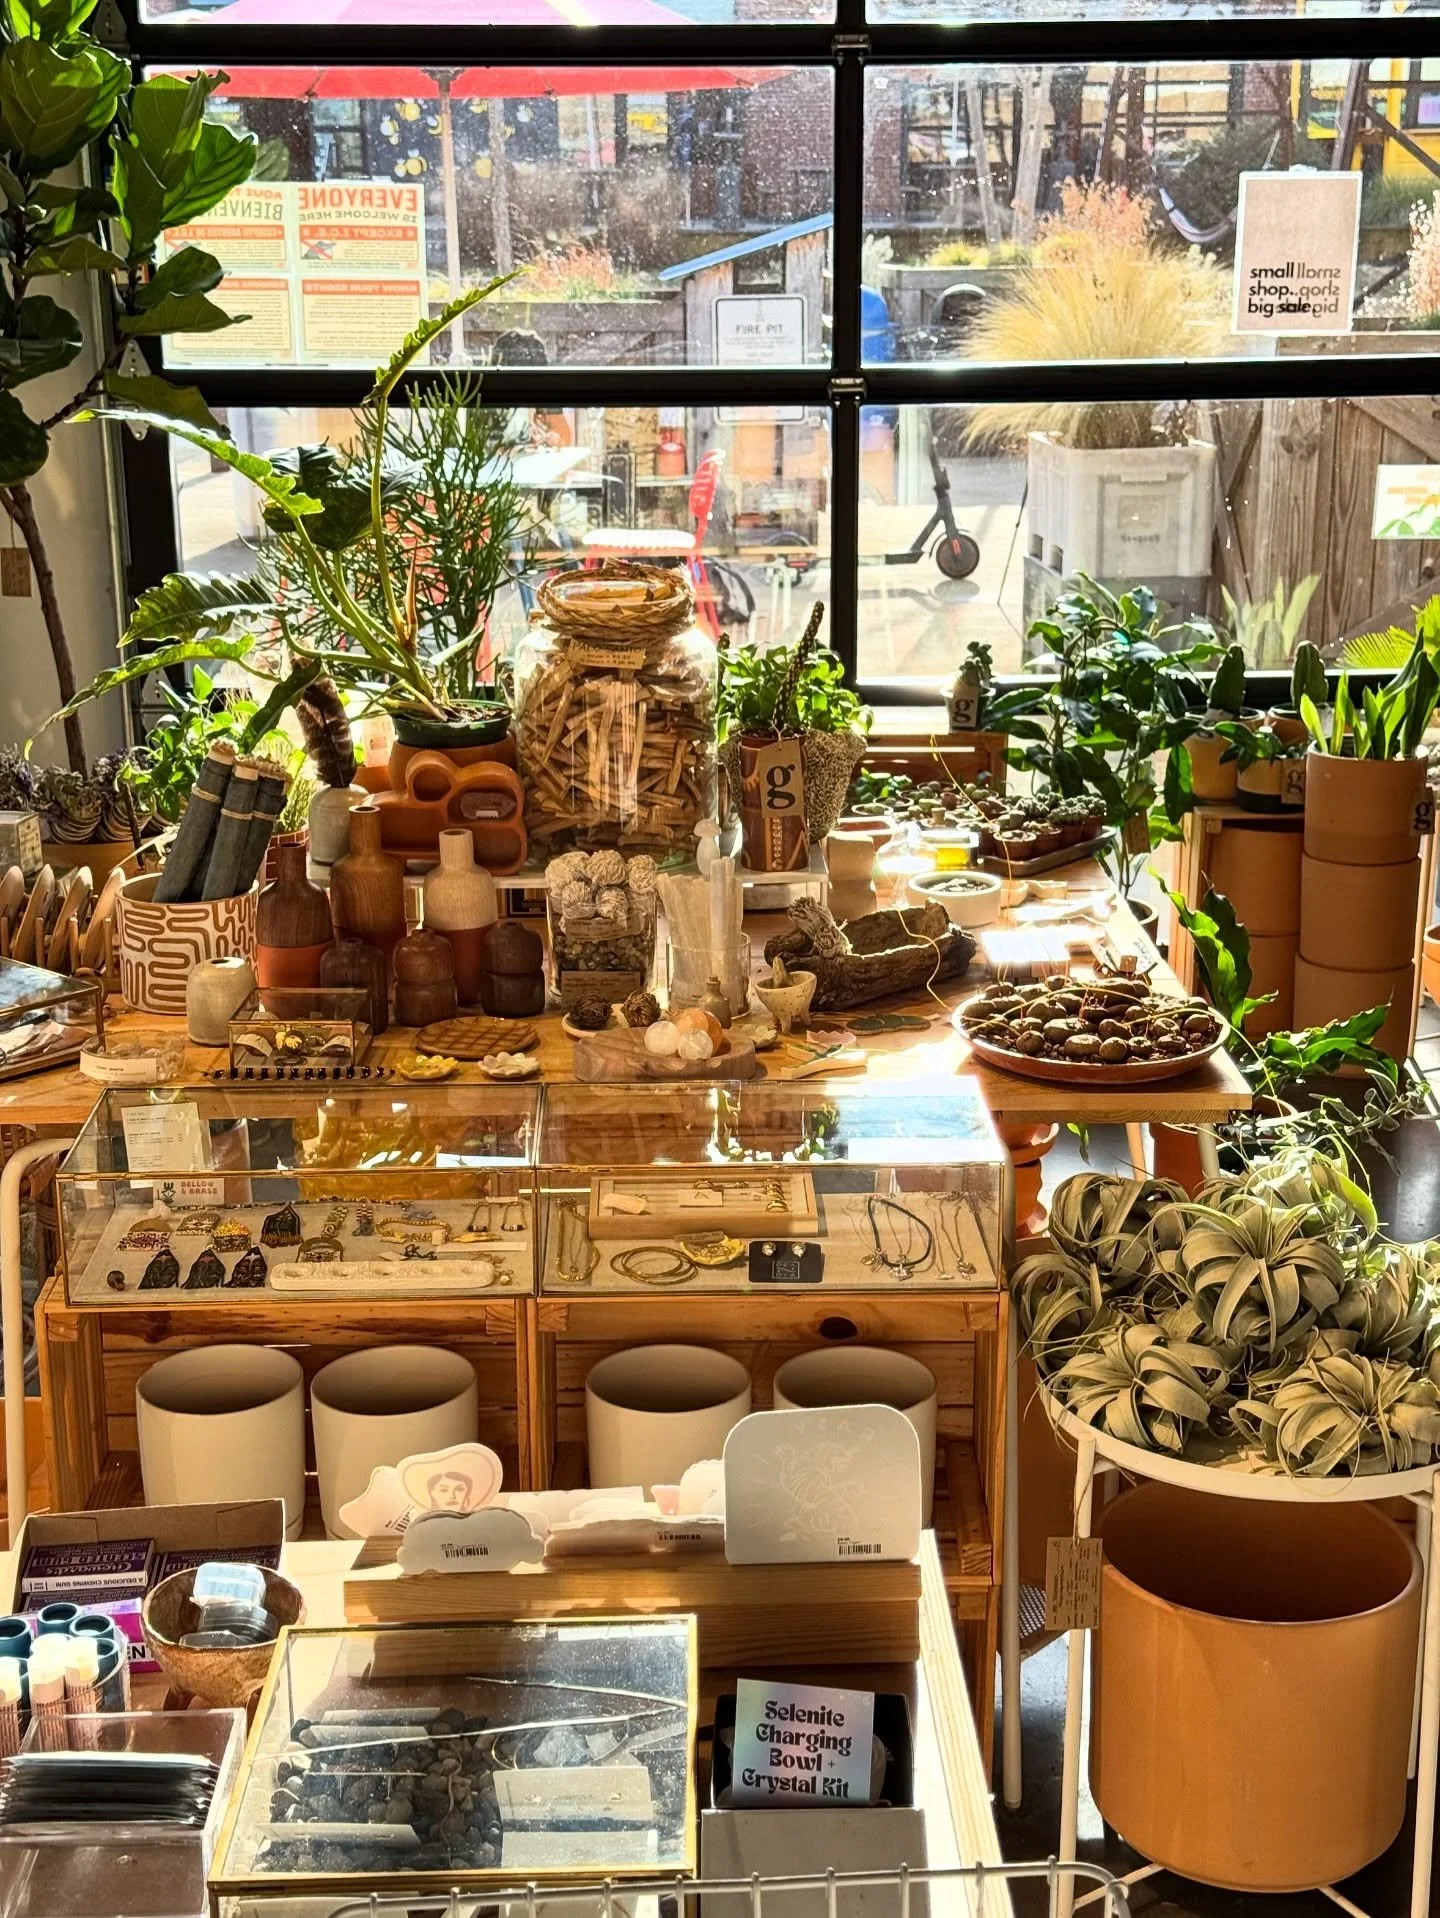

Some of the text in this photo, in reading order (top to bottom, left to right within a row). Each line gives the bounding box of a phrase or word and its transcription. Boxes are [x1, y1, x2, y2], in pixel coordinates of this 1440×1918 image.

[1250, 262, 1294, 278] small
[1248, 298, 1273, 318] big
[736, 324, 783, 334] FIRE PIT
[952, 699, 974, 724] g
[766, 764, 795, 810] g
[1287, 769, 1304, 793] g
[1414, 801, 1433, 831] g
[765, 1701, 845, 1727] Selenite
[756, 1723, 852, 1756] Charging
[769, 1748, 822, 1772] Bowl
[742, 1768, 849, 1798] Crystal Kit
